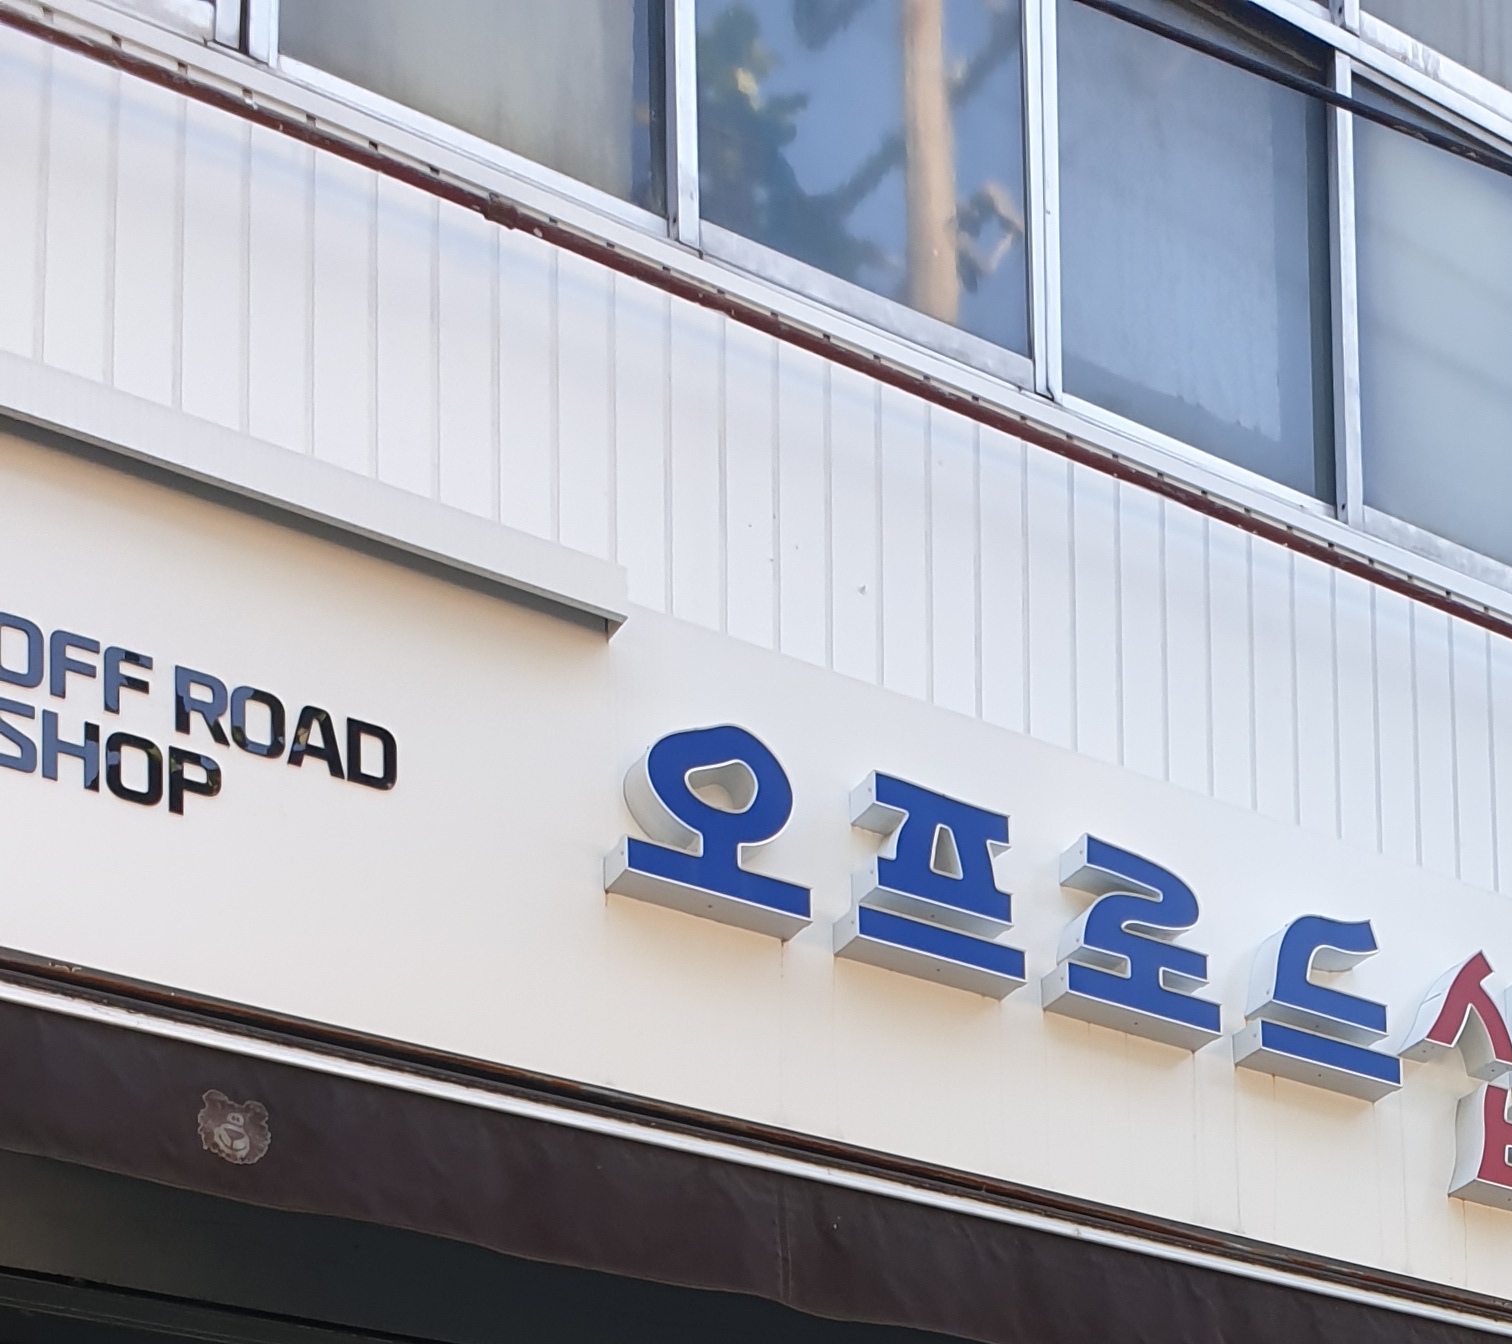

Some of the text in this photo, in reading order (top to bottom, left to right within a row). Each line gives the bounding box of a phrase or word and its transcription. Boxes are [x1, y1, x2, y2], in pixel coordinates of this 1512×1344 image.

[0, 612, 398, 791] OFF ROAD
[0, 699, 222, 815] SHOP
